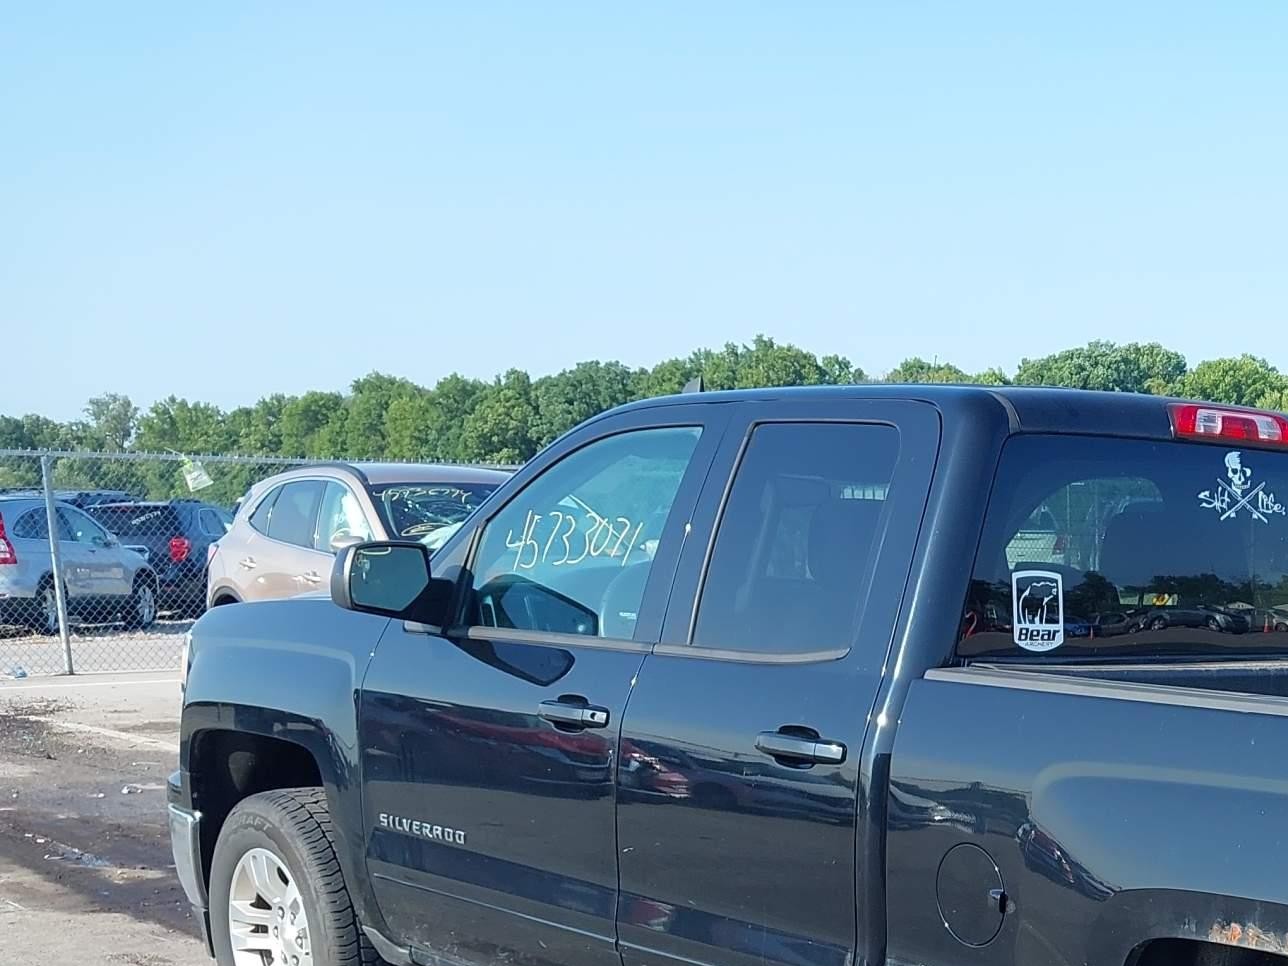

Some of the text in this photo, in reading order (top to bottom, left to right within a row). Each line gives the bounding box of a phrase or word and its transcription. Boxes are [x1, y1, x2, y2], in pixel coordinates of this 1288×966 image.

[505, 509, 644, 572] 45733071
[1017, 627, 1061, 641] Bear
[379, 813, 465, 845] SILVERADO
